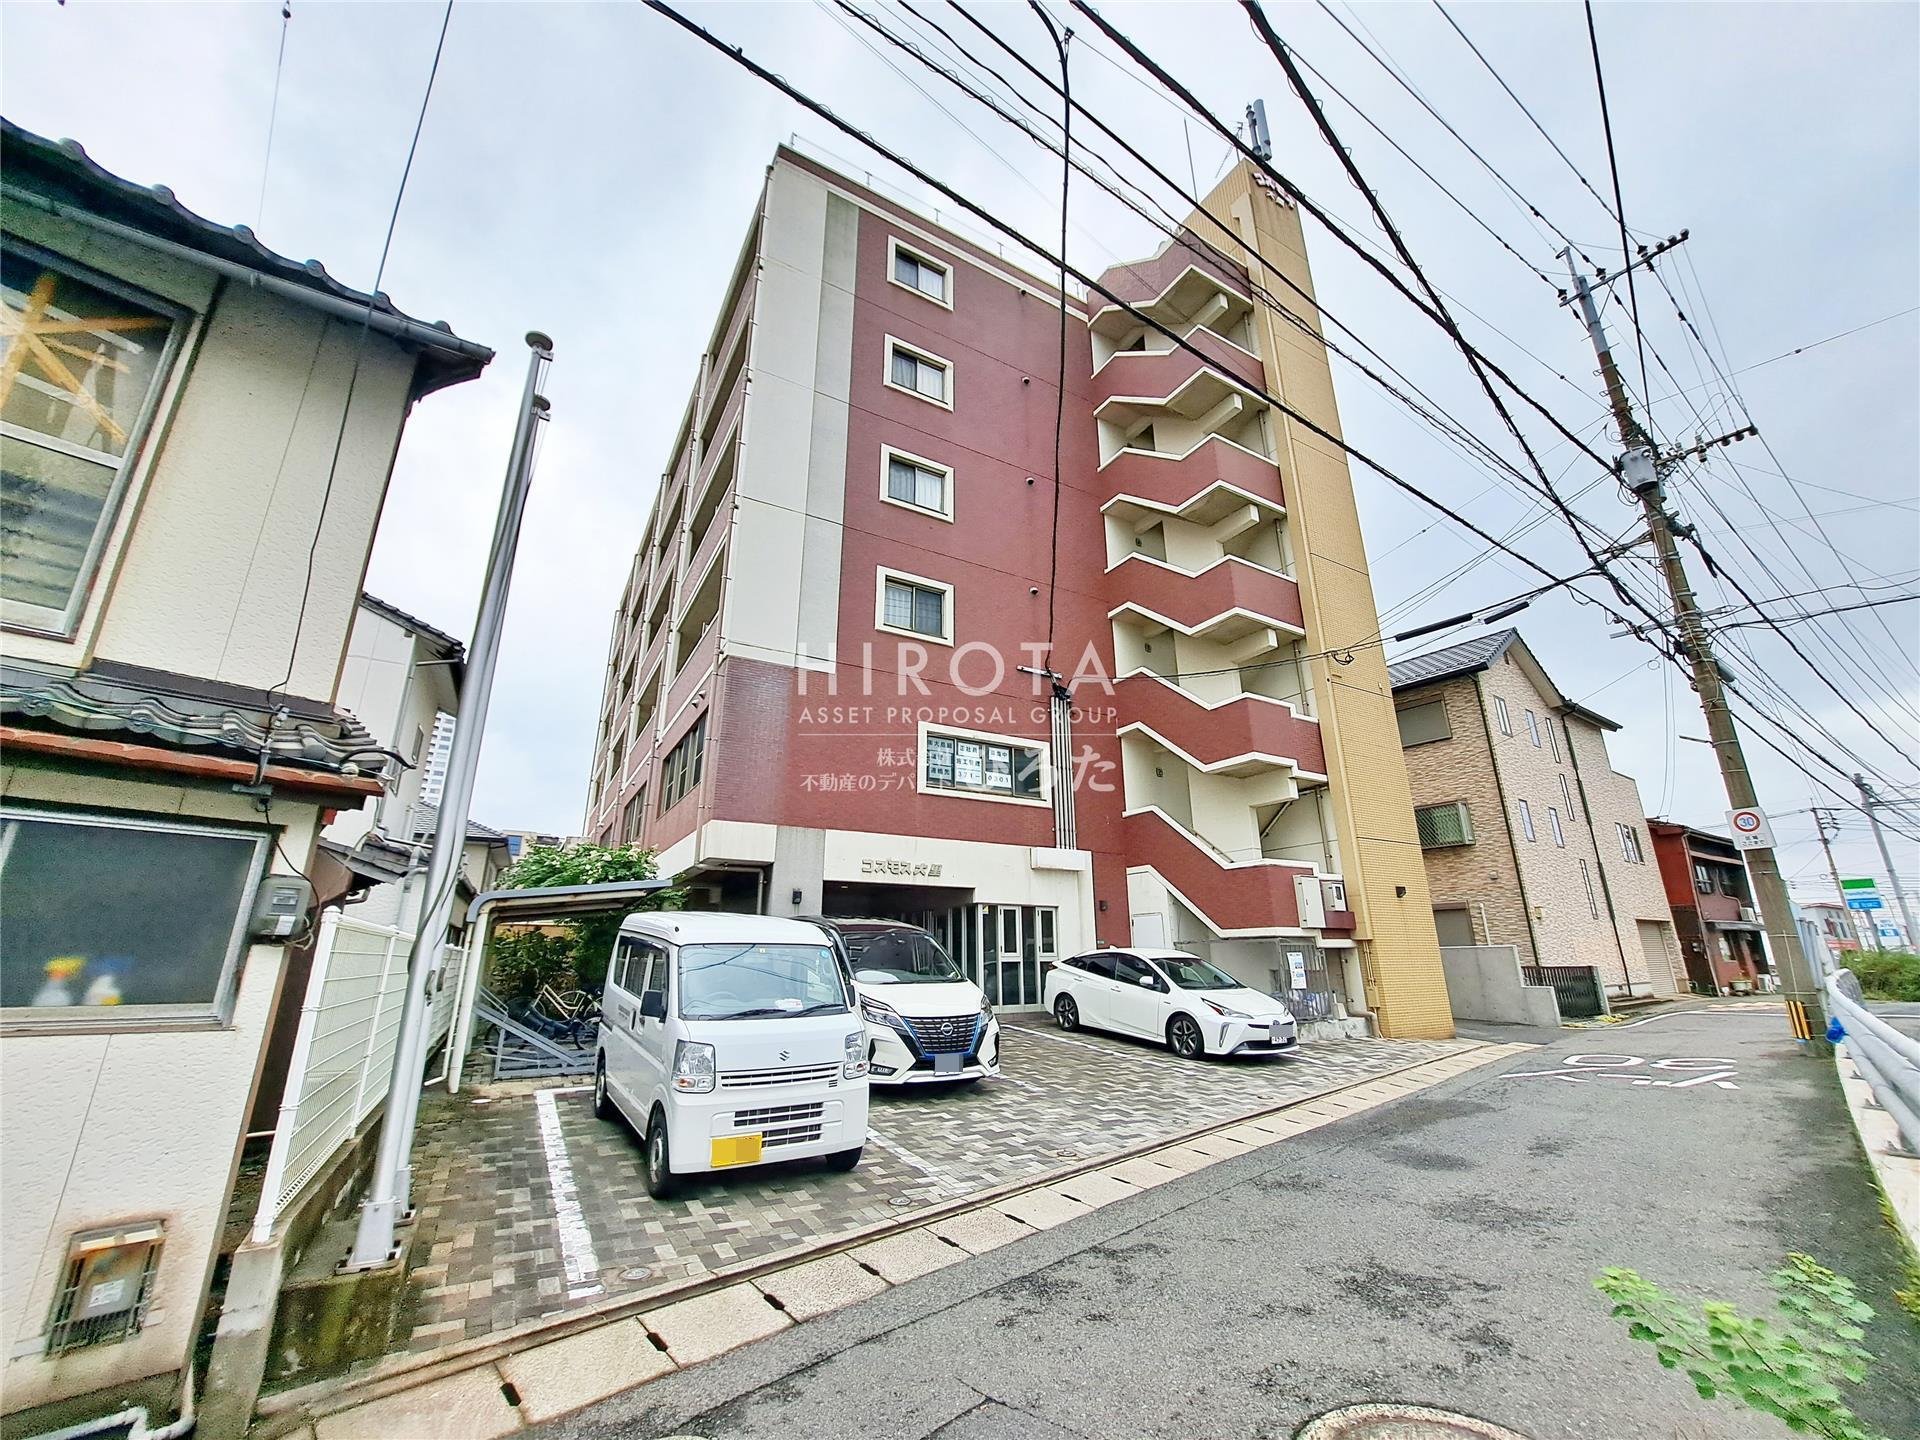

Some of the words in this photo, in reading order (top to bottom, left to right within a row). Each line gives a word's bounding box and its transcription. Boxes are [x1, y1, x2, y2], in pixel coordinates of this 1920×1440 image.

[1739, 816, 1755, 827] 30
[861, 858, 943, 878] コスモス大里
